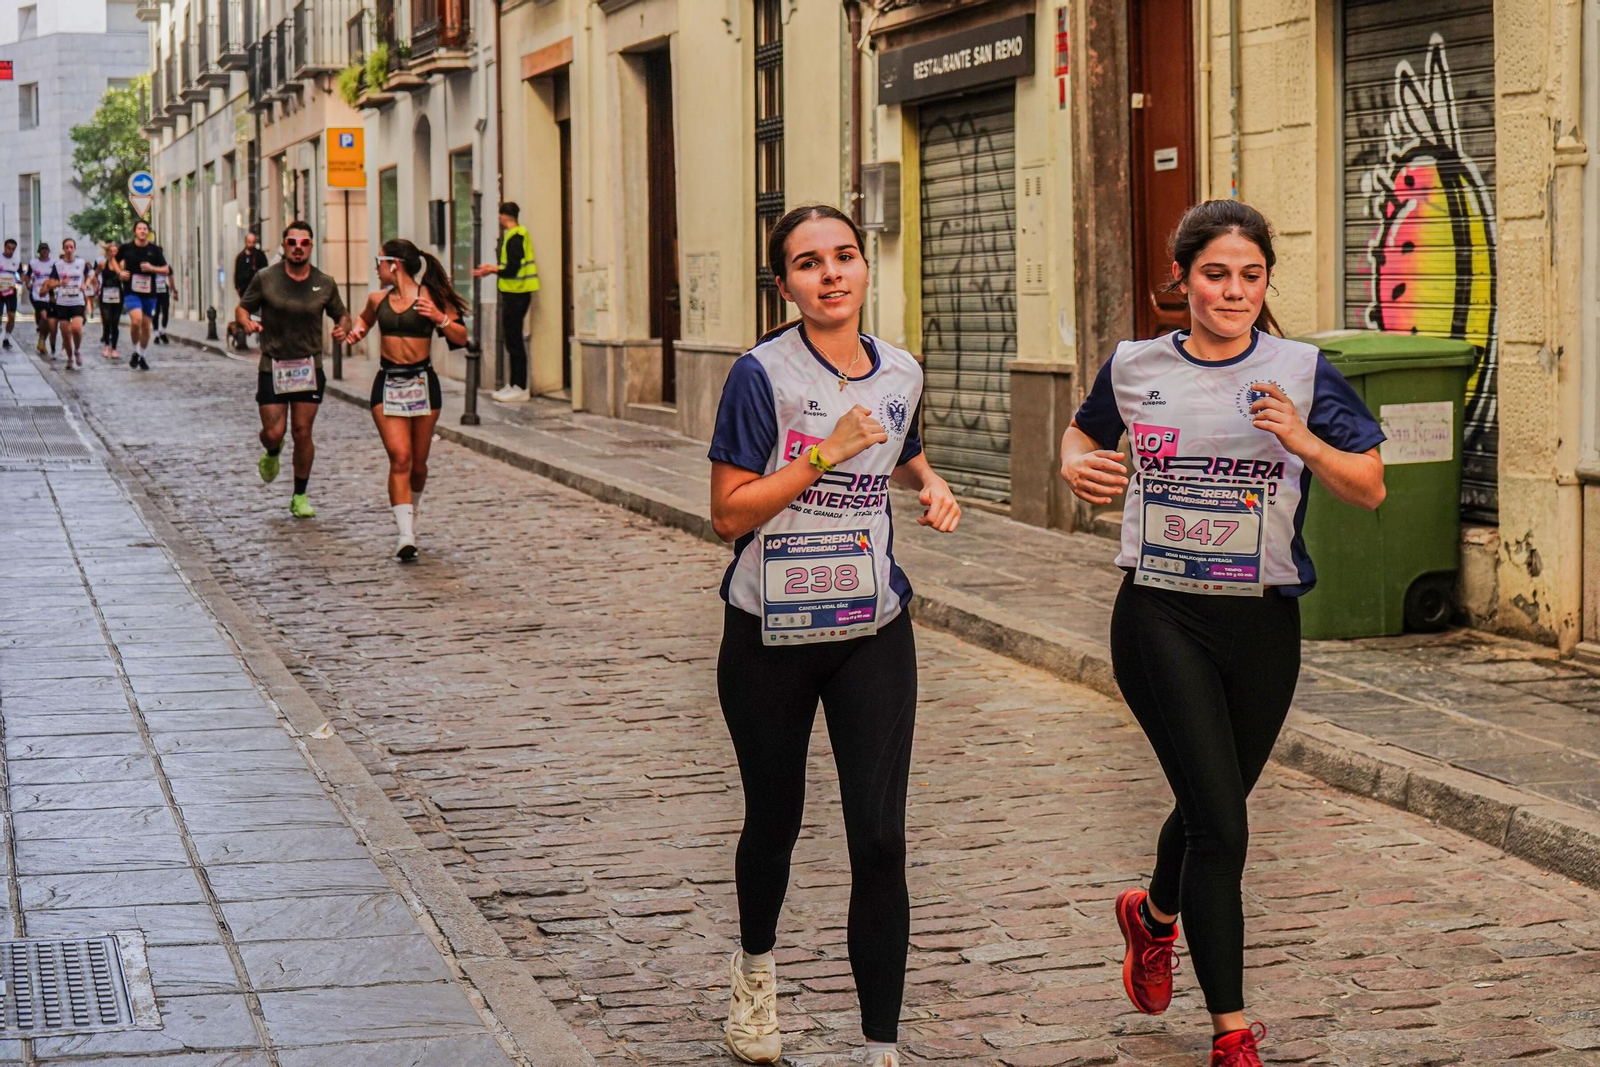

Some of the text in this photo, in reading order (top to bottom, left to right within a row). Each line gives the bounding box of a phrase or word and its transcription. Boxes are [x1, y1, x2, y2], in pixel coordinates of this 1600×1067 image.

[913, 35, 1023, 80] RESTAURANTE SAN REMO
[340, 132, 354, 148] P
[1140, 456, 1286, 480] CARRERA
[1168, 483, 1239, 500] CARRERA
[1168, 494, 1219, 506] UNIVERSIDAD
[813, 510, 843, 518] GRANADA
[1163, 514, 1240, 547] 347
[787, 533, 856, 546] CARRERA
[787, 545, 838, 554] UNIVERSIDAD
[784, 563, 860, 595] 238
[837, 601, 849, 609] DÍAZ
